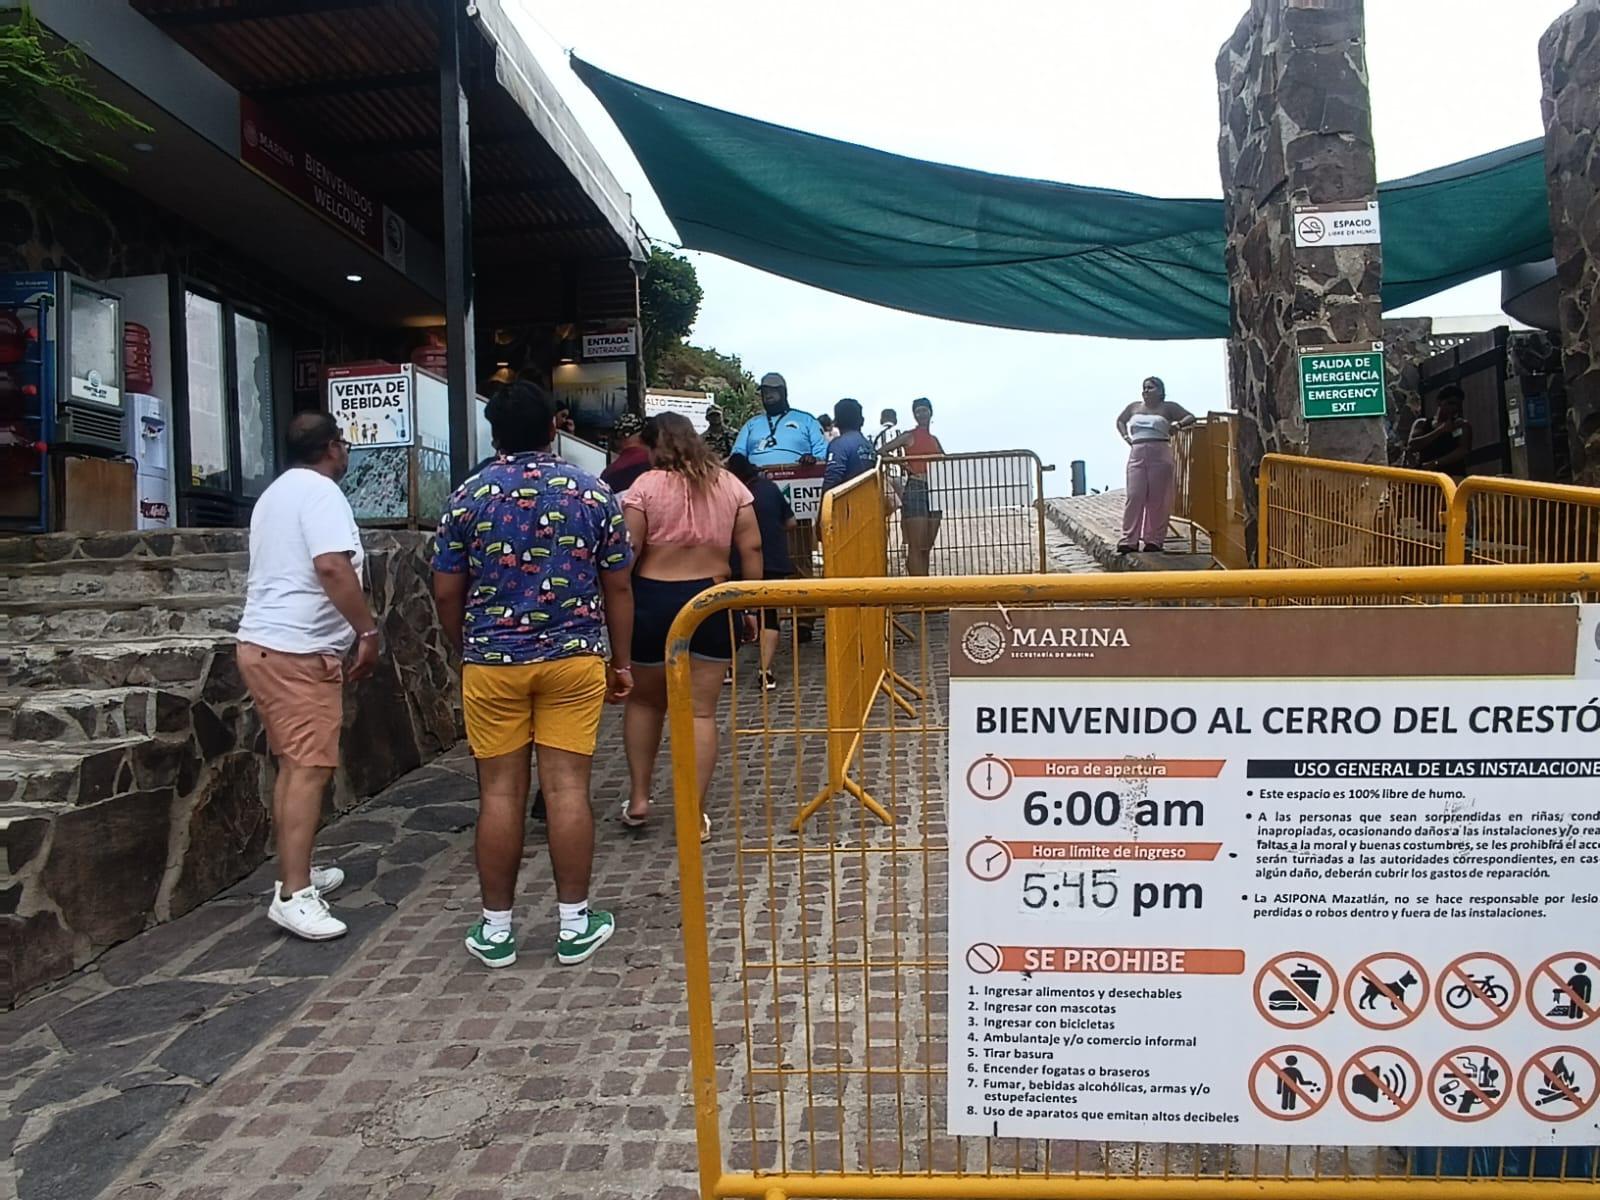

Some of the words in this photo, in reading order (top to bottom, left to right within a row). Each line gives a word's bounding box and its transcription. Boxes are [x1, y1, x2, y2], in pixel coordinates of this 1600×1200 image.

[304, 152, 373, 217] BIENVENIDOS
[313, 185, 367, 236] WELCOME
[1333, 219, 1371, 228] ESPACIO
[587, 336, 630, 346] ENTRADA
[587, 345, 631, 355] ENTRANCE
[1312, 359, 1352, 370] SALIDA
[1355, 357, 1371, 367] DE
[1305, 370, 1380, 383] EMERGENCIA
[335, 383, 382, 397] VENTA
[386, 380, 405, 394] DE
[1308, 388, 1378, 400] EMERGENCY
[341, 395, 401, 410] BEBIDAS
[1331, 402, 1356, 412] EXIT
[1011, 627, 1131, 647] MARINA
[975, 706, 1197, 735] BIENVENIDO
[1207, 706, 1252, 734] AL
[1262, 705, 1382, 735] CERRO
[1393, 705, 1457, 735] DEL
[1045, 763, 1079, 776] Hora
[1084, 763, 1101, 776] de
[1105, 764, 1166, 778] apertura
[1293, 762, 1330, 778] USO
[1335, 762, 1413, 778] GENERAL
[1418, 762, 1441, 777] DE
[1445, 761, 1475, 777] LAS
[1259, 789, 1284, 799] Este
[1286, 789, 1331, 801] espacio
[1333, 791, 1346, 799] es
[1348, 789, 1380, 799] 100%
[1382, 789, 1409, 799] libre
[1411, 788, 1426, 799] de
[1428, 788, 1466, 799] humo.
[1024, 790, 1120, 826] 6:00
[1135, 800, 1204, 826] am
[1258, 812, 1267, 822] A
[1275, 812, 1291, 822] las
[1299, 814, 1352, 824] personas
[1359, 814, 1382, 823] que
[1389, 814, 1417, 822] sean
[1425, 812, 1501, 824] sorprendidas
[1508, 813, 1523, 822] en
[1257, 826, 1337, 838] inapropiadas,
[1338, 826, 1412, 836] ocasionando
[1414, 826, 1450, 836] daños
[1452, 828, 1459, 836] a
[1463, 825, 1479, 836] las
[1482, 826, 1557, 836] instalaciones
[1559, 824, 1580, 838] y/o
[1033, 845, 1065, 858] Hora
[1114, 845, 1131, 858] de
[1134, 845, 1186, 859] ingreso
[1257, 840, 1289, 851] faltas
[1290, 842, 1298, 850] a
[1300, 840, 1311, 850] la
[1313, 840, 1347, 850] moral
[1349, 842, 1357, 852] y
[1359, 840, 1401, 850] buenas
[1403, 839, 1474, 851] costumbres,
[1476, 842, 1489, 850] se
[1491, 840, 1507, 850] les
[1510, 840, 1563, 852] prohibirá
[1256, 854, 1287, 864] serán
[1293, 854, 1344, 864] turnadas
[1359, 854, 1376, 864] las
[1380, 854, 1449, 865] autoridades
[1453, 853, 1557, 866] correspondientes,
[1560, 855, 1575, 864] en
[1255, 868, 1287, 880] algún
[1289, 868, 1322, 880] daño,
[1324, 868, 1372, 878] deberán
[1374, 868, 1409, 878] cubrir
[1411, 868, 1428, 878] los
[1430, 869, 1468, 880] gastos
[1469, 869, 1484, 878] de
[1486, 867, 1550, 880] reparación.
[1022, 869, 1119, 909] 5:45
[1133, 881, 1203, 917] pm
[1254, 893, 1267, 903] La
[1273, 893, 1327, 904] ASIPONA
[1332, 893, 1389, 905] Mazatlán,
[1394, 896, 1410, 904] no
[1416, 896, 1430, 904] se
[1435, 894, 1463, 904] hace
[1469, 893, 1539, 905] responsable
[1544, 895, 1565, 905] por
[1253, 907, 1303, 919] perdidas
[1305, 910, 1313, 918] o
[1315, 907, 1348, 918] robos
[1350, 907, 1389, 918] dentro
[1391, 910, 1399, 920] y
[1401, 908, 1431, 918] fuera
[1433, 908, 1448, 918] de
[1451, 908, 1467, 918] las
[1468, 908, 1547, 918] instalaciones.
[1024, 949, 1055, 971] SE
[1065, 950, 1185, 973] PROHIBE
[968, 985, 979, 995] 1.
[984, 985, 1033, 998] Ingresar
[1036, 986, 1095, 998] alimentos
[1098, 989, 1105, 1000] y
[1108, 988, 1182, 999] desechables
[967, 1001, 979, 1011] 2.
[984, 1002, 1032, 1014] Ingresar
[1035, 1005, 1057, 1013] con
[1060, 1005, 1117, 1014] mascotas
[967, 1017, 979, 1026] 3.
[984, 1017, 1032, 1029] Ingresar
[1035, 1020, 1057, 1029] con
[1060, 1019, 1115, 1030] bicicletas
[967, 1032, 979, 1042] 4.
[983, 1032, 1060, 1046] Ambulantaje
[1063, 1034, 1084, 1047] y/o
[1086, 1036, 1142, 1046] comercio
[1145, 1035, 1197, 1047] informal
[967, 1048, 978, 1058] 5.
[983, 1048, 1011, 1059] Tirar
[1014, 1049, 1054, 1060] basura
[967, 1064, 978, 1073] 6.
[983, 1064, 1039, 1074] Encender
[1042, 1064, 1085, 1077] fogatas
[1088, 1068, 1096, 1076] o
[1099, 1066, 1150, 1077] braseros
[967, 1078, 978, 1088] 7.
[983, 1079, 1026, 1091] Fumar,
[1029, 1080, 1075, 1091] bebidas
[1078, 1081, 1147, 1094] alcohólicas,
[1150, 1085, 1187, 1094] armas
[1190, 1083, 1211, 1096] y/o
[984, 1092, 1078, 1104] estupefacientes
[967, 1106, 978, 1115] 8.
[983, 1106, 1005, 1117] Uso
[1008, 1107, 1023, 1117] de
[1026, 1109, 1078, 1120] aparatos
[1081, 1111, 1104, 1121] que
[1106, 1110, 1148, 1121] emitan
[1151, 1111, 1181, 1122] altos
[1183, 1112, 1239, 1123] decibeles
